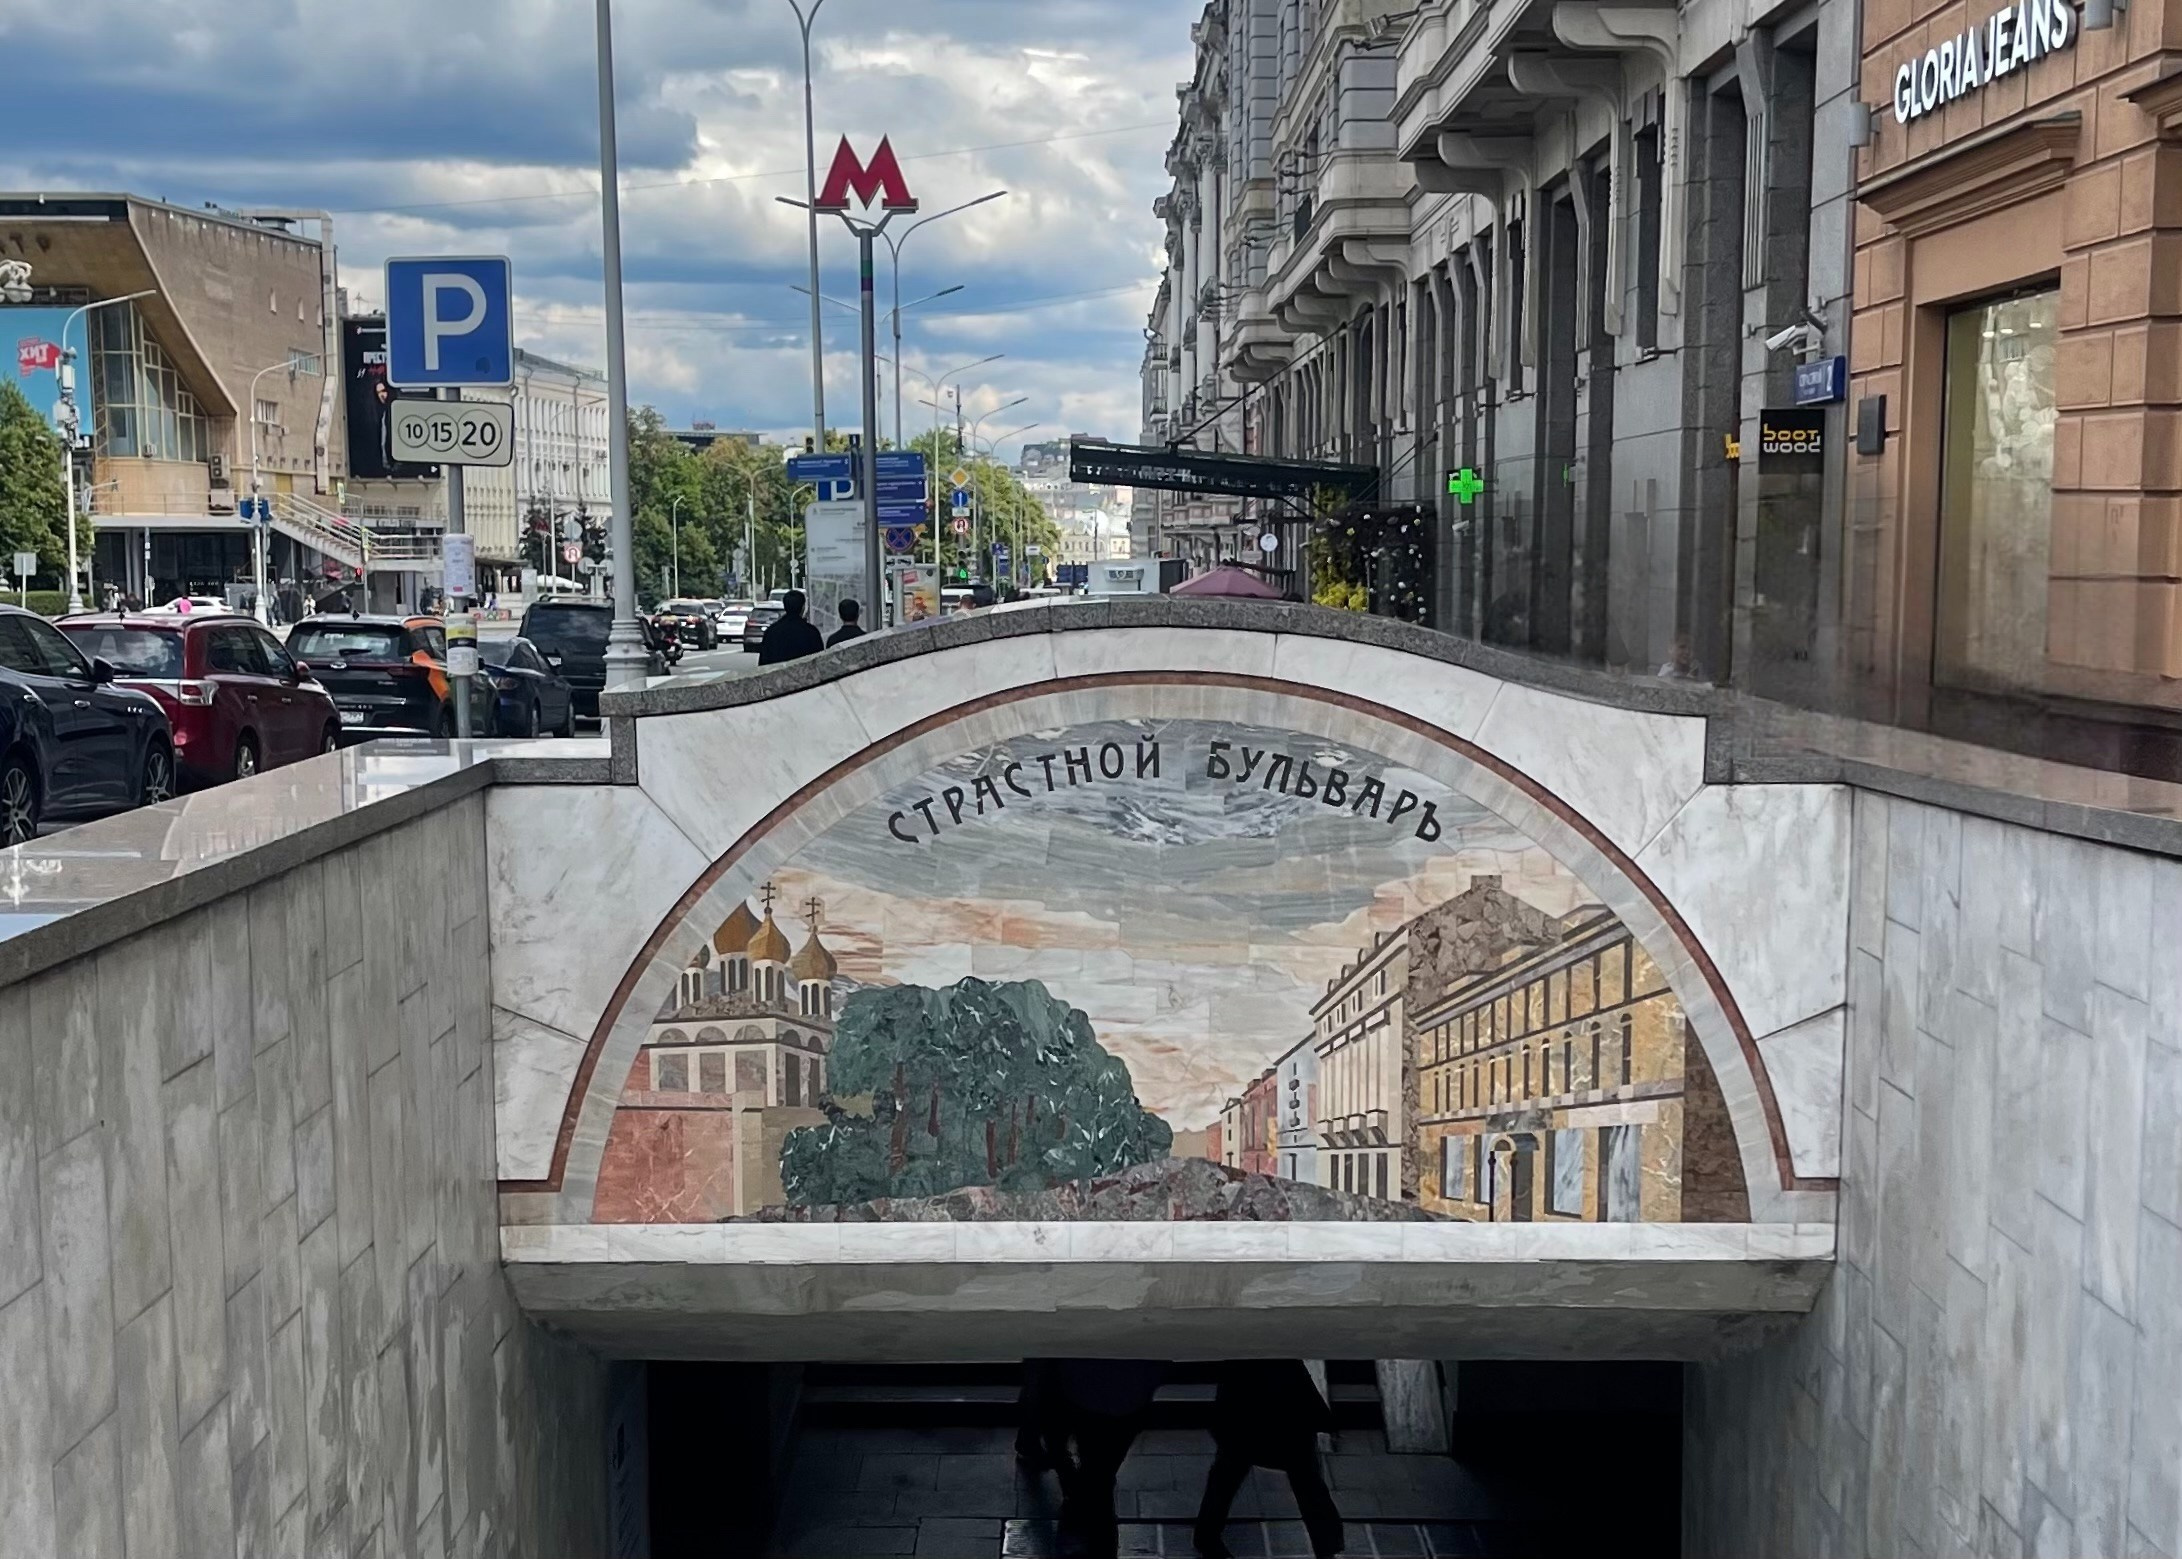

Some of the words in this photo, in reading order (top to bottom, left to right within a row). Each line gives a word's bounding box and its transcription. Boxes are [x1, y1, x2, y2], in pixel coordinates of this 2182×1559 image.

[1894, 25, 1978, 124] GLORIA
[1983, 0, 2069, 84] JEANS
[422, 272, 488, 371] P
[19, 343, 49, 364] ХИТ
[405, 423, 424, 439] 10
[431, 422, 453, 443] 15
[462, 420, 496, 447] 20
[1763, 422, 1819, 441] boot
[1763, 435, 1821, 453] wood
[887, 733, 1161, 844] СТРАСТНОЙ
[1206, 740, 1442, 843] БУЛЬВАРЪ
